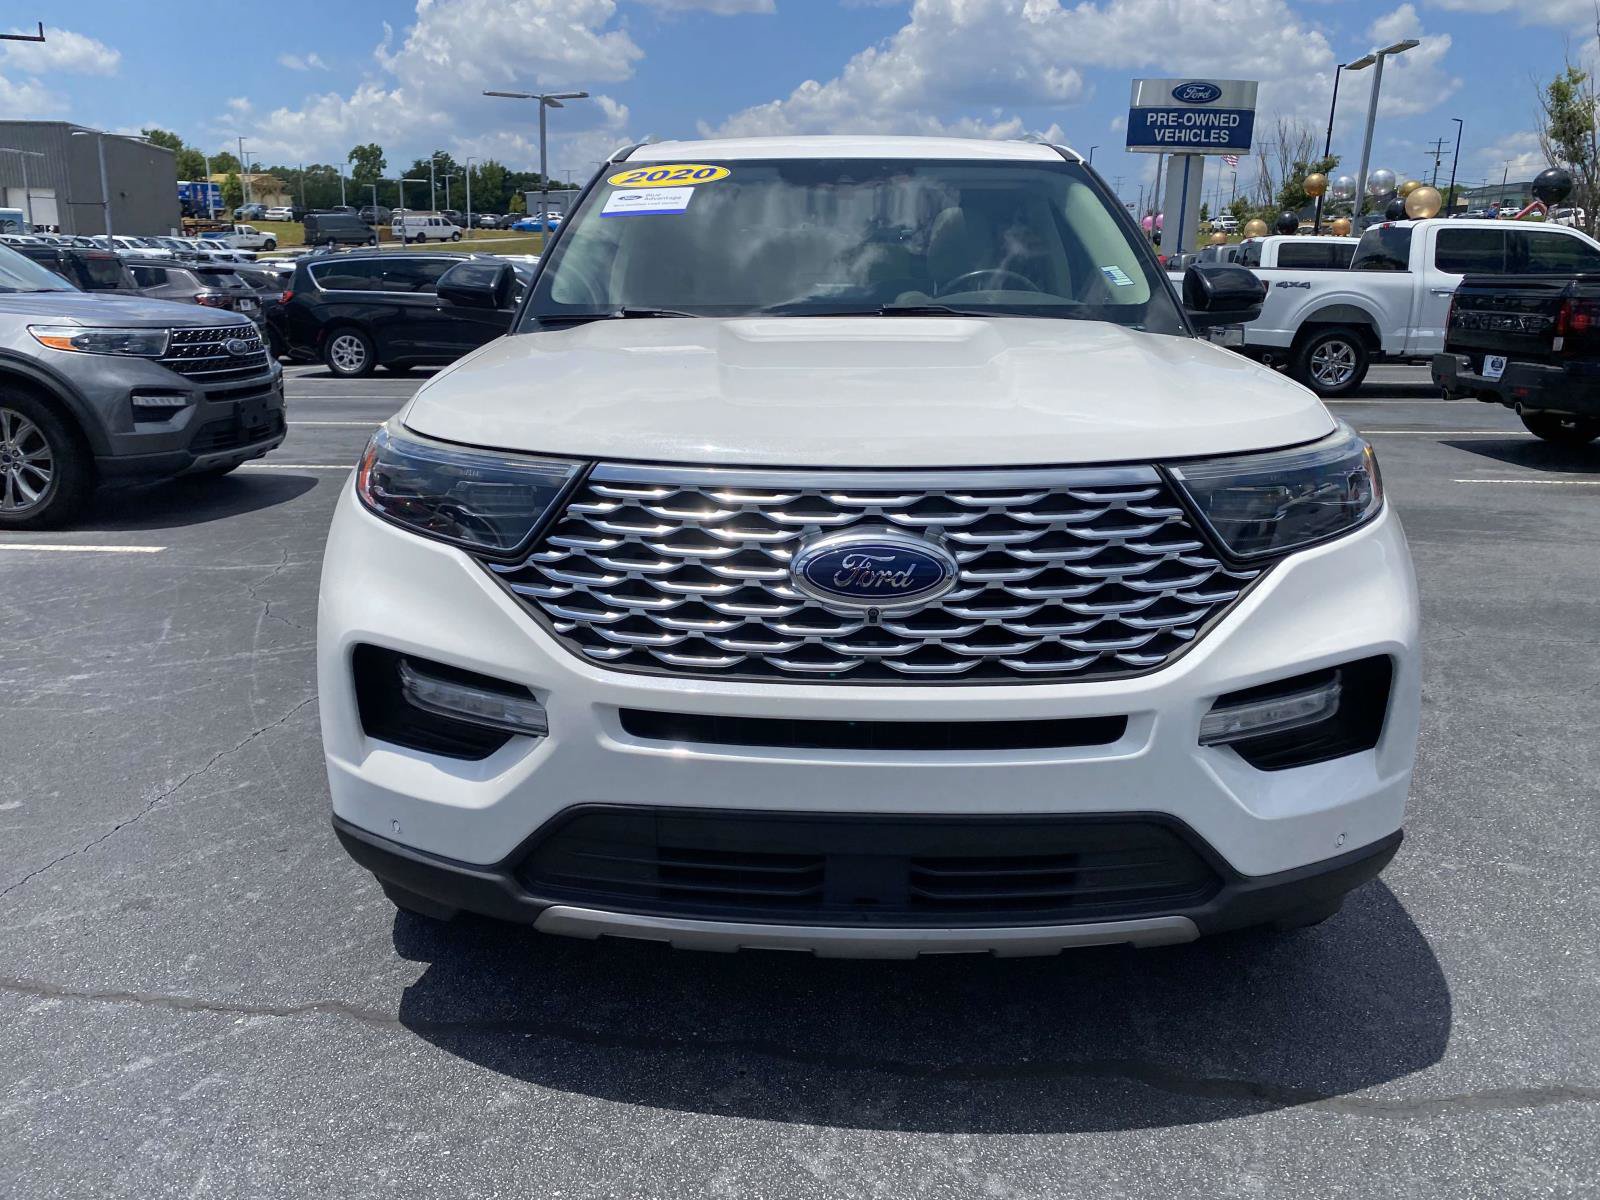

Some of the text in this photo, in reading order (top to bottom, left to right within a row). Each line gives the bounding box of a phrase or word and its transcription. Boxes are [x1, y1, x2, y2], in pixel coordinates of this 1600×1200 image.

[1183, 86, 1212, 99] Ford
[1146, 112, 1240, 127] PRE-OWNED
[1154, 129, 1230, 142] VEHICLES
[621, 168, 718, 183] 2020
[833, 553, 917, 588] Ford
